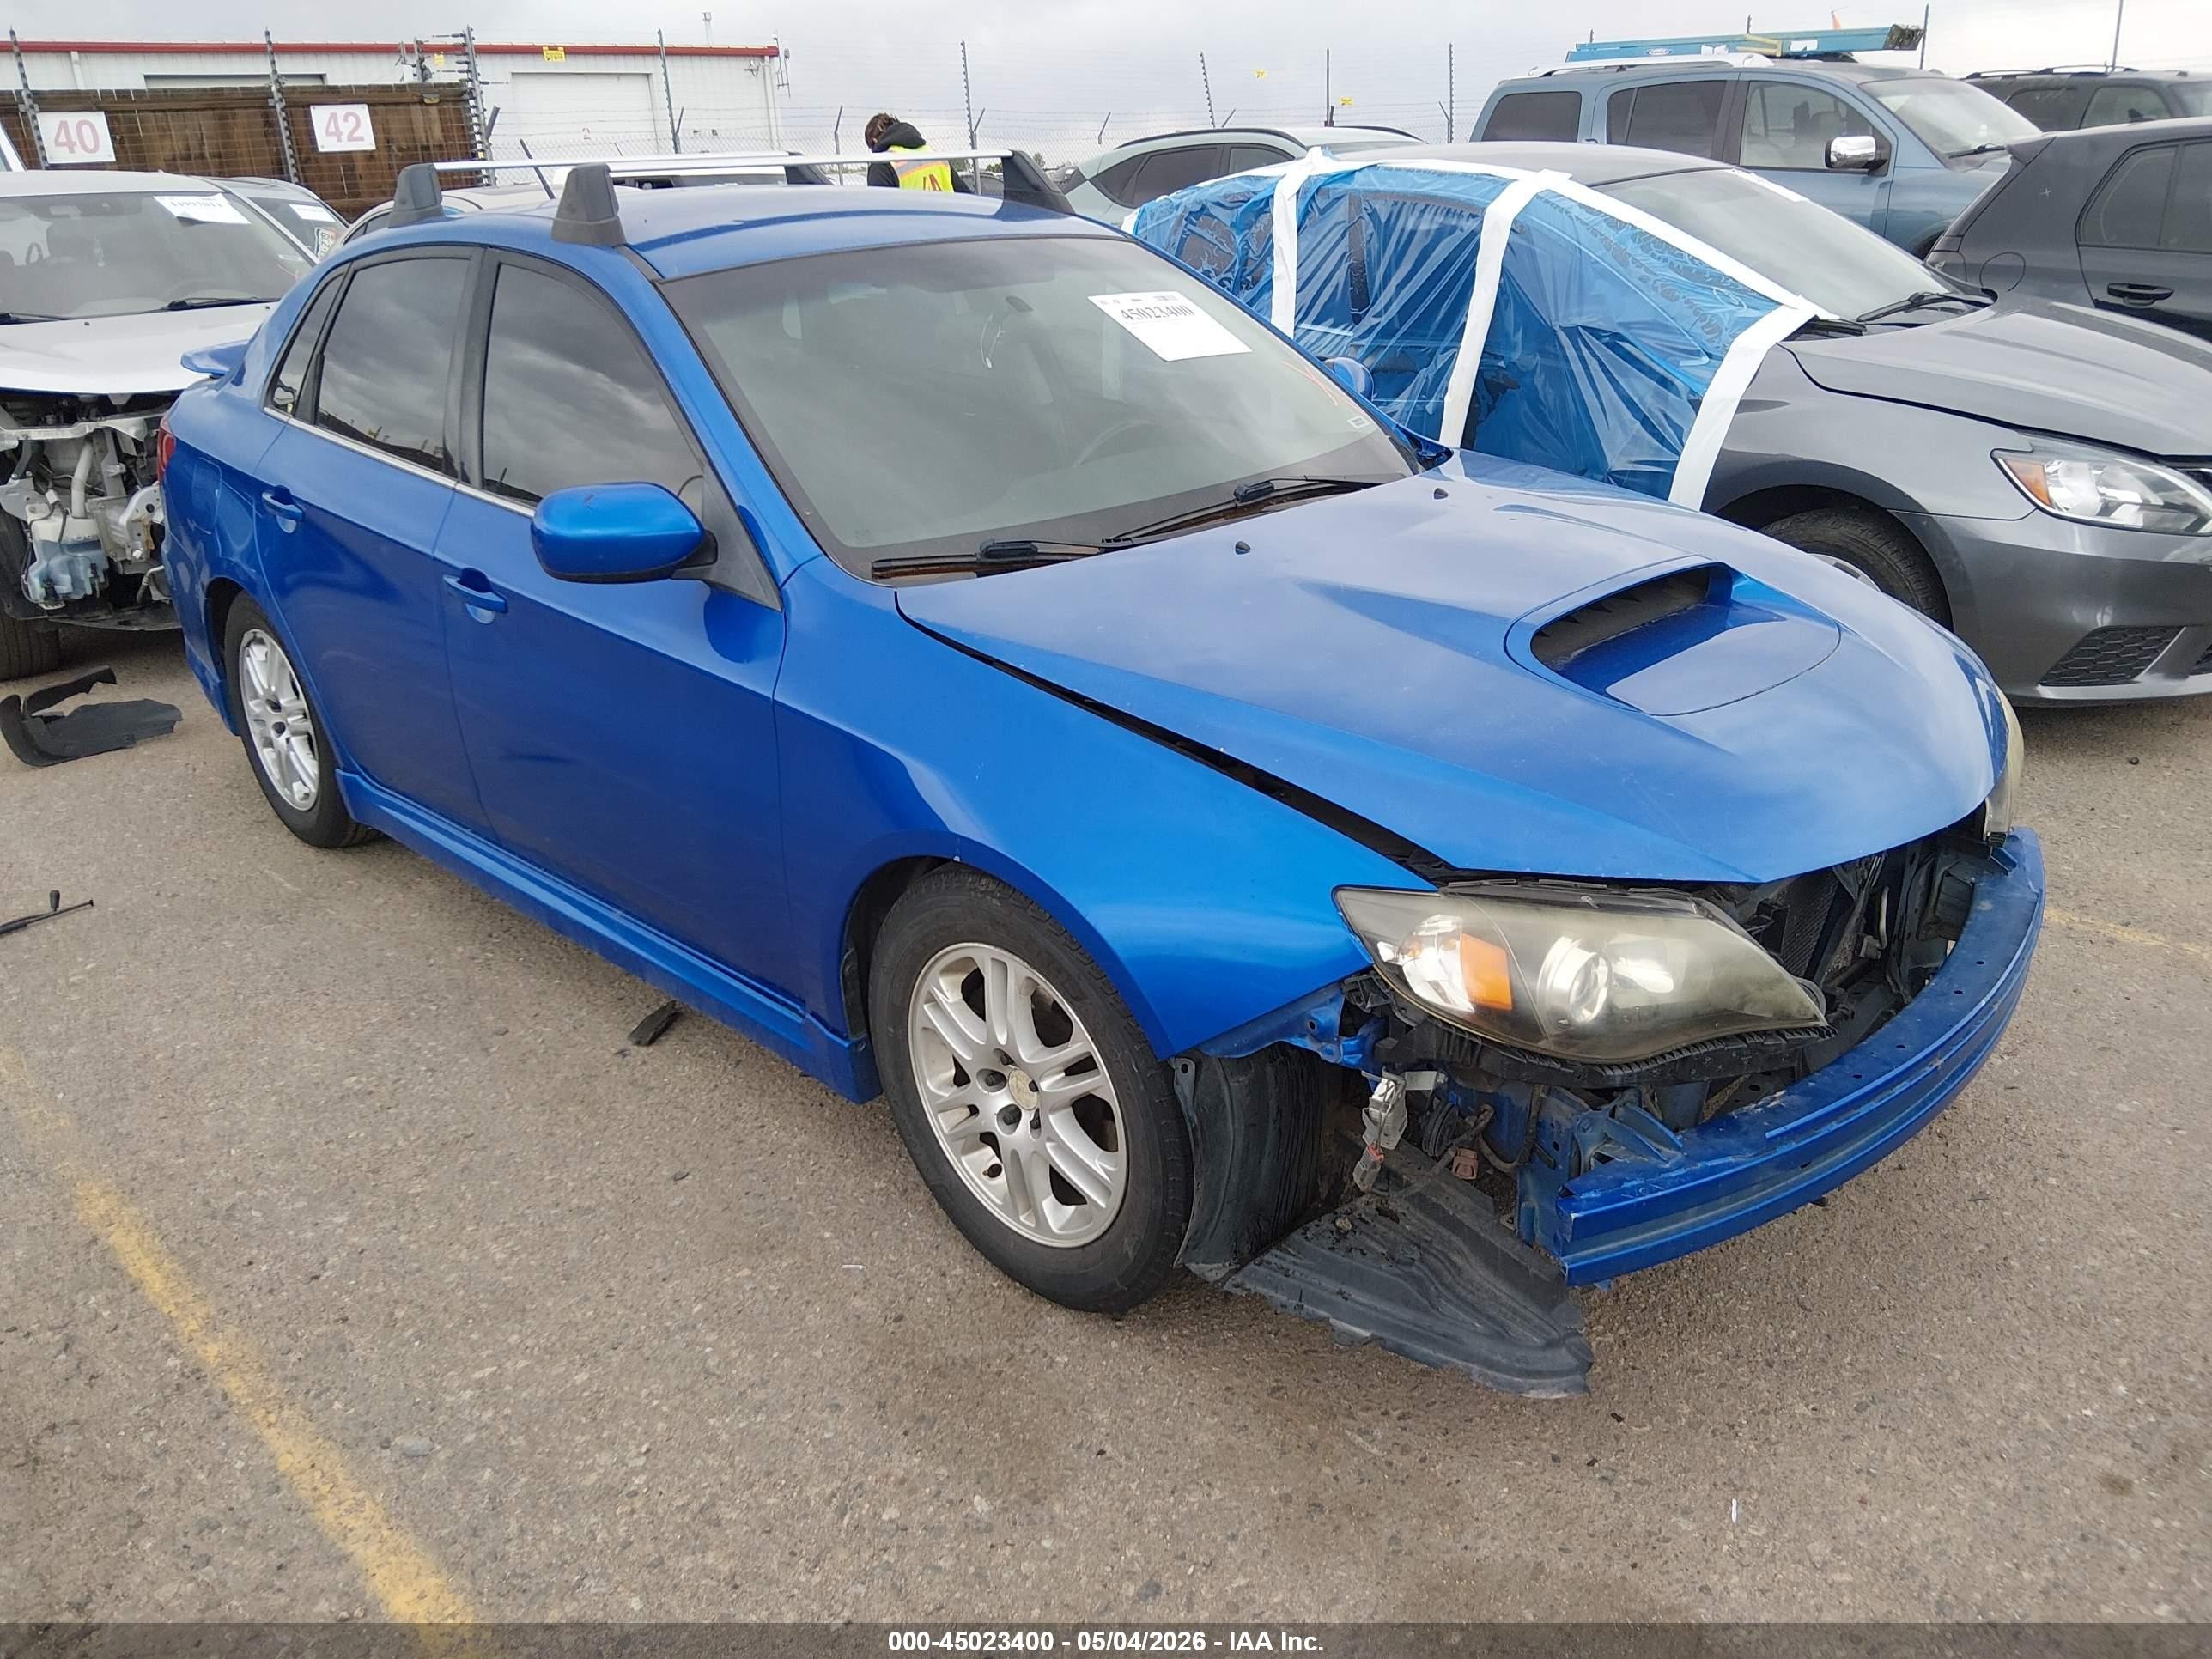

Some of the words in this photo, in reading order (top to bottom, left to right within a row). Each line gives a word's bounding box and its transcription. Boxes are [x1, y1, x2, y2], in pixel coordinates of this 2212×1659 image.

[53, 119, 101, 155] 40
[325, 111, 365, 143] 42
[1121, 305, 1195, 320] 45023400
